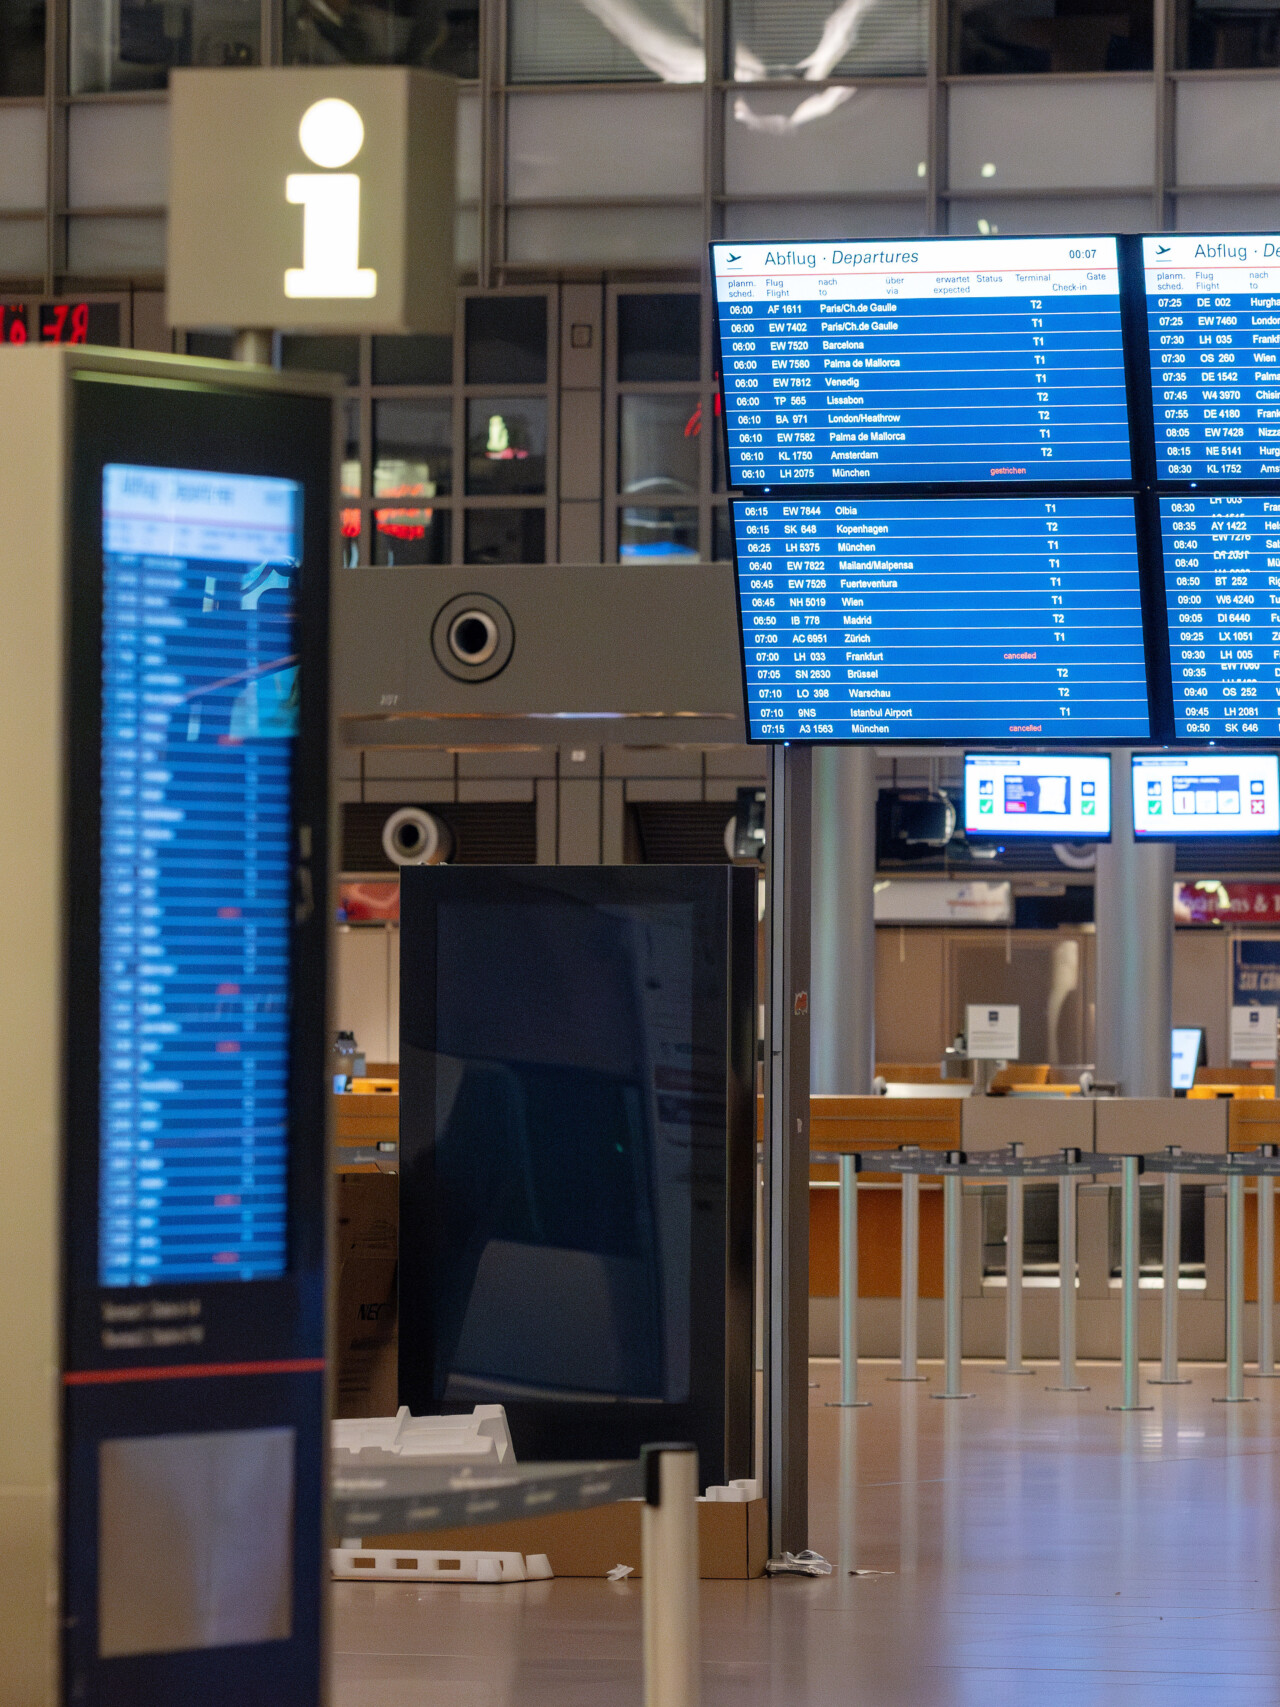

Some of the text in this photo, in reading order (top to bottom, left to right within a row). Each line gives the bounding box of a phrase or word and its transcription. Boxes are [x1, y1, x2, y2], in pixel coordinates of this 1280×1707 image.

[1069, 250, 1096, 258] 00:07
[1195, 244, 1246, 261] Abflug
[765, 251, 918, 268] Abflug Departures
[766, 279, 783, 288] Flug
[730, 306, 753, 314] 06:00
[768, 305, 779, 314] AF
[782, 305, 801, 313] 1611
[870, 303, 897, 312] Gaulle
[1030, 300, 1042, 309] T2
[1158, 298, 1182, 307] 07:25
[1197, 298, 1211, 307] DE
[1215, 298, 1231, 306] 002
[1164, 391, 1187, 400] 07:45
[1202, 391, 1217, 400] W4
[1219, 391, 1240, 399] 3970
[742, 467, 1026, 478] 06:10 LH 2075 München gestrichen
[1177, 577, 1200, 585] 08:50
[1215, 577, 1227, 585] BT
[1232, 577, 1247, 585] 252
[1182, 650, 1205, 659] 09:30
[1220, 650, 1232, 659] LH
[1237, 650, 1253, 659] 005
[759, 688, 1069, 698] 07:10 LO 398 Warschau T2
